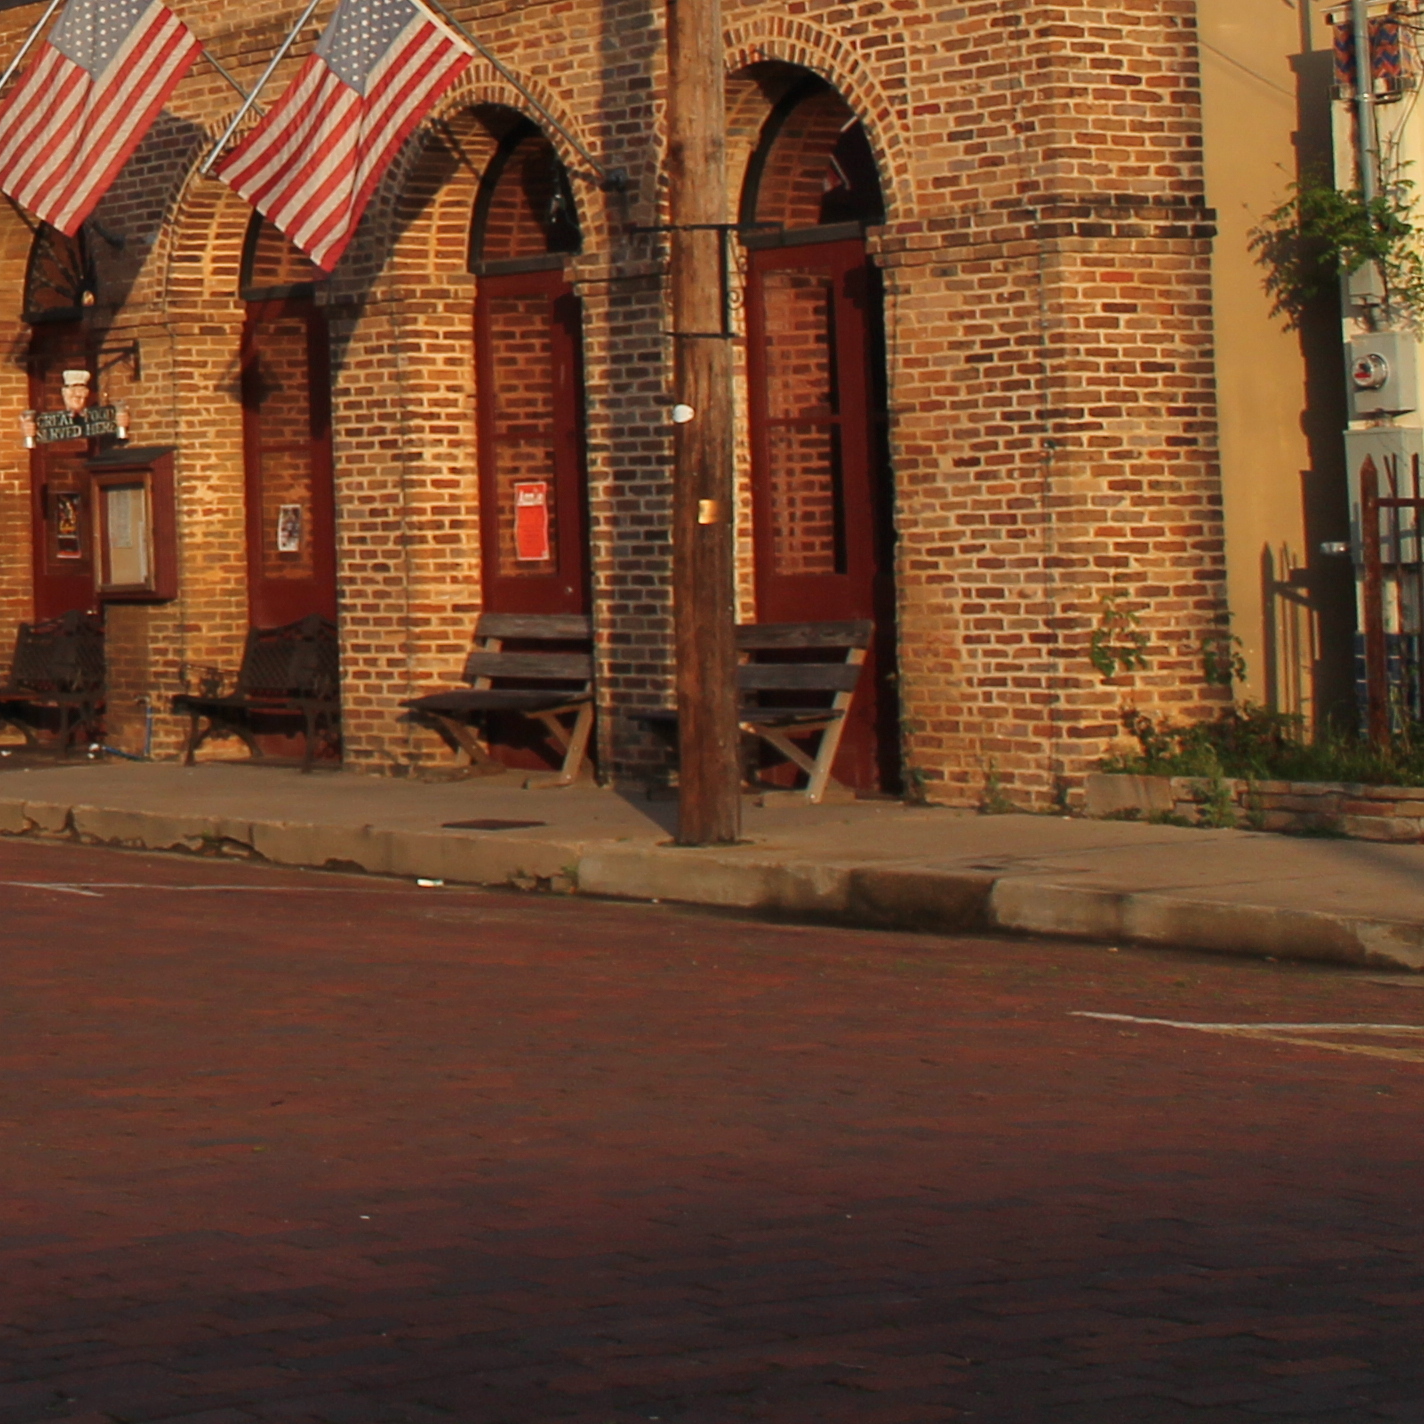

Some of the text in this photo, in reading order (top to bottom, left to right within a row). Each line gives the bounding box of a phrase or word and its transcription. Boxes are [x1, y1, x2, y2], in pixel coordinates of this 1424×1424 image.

[37, 408, 116, 427] GREAT FOOD
[36, 422, 117, 442] SERVED HERE
